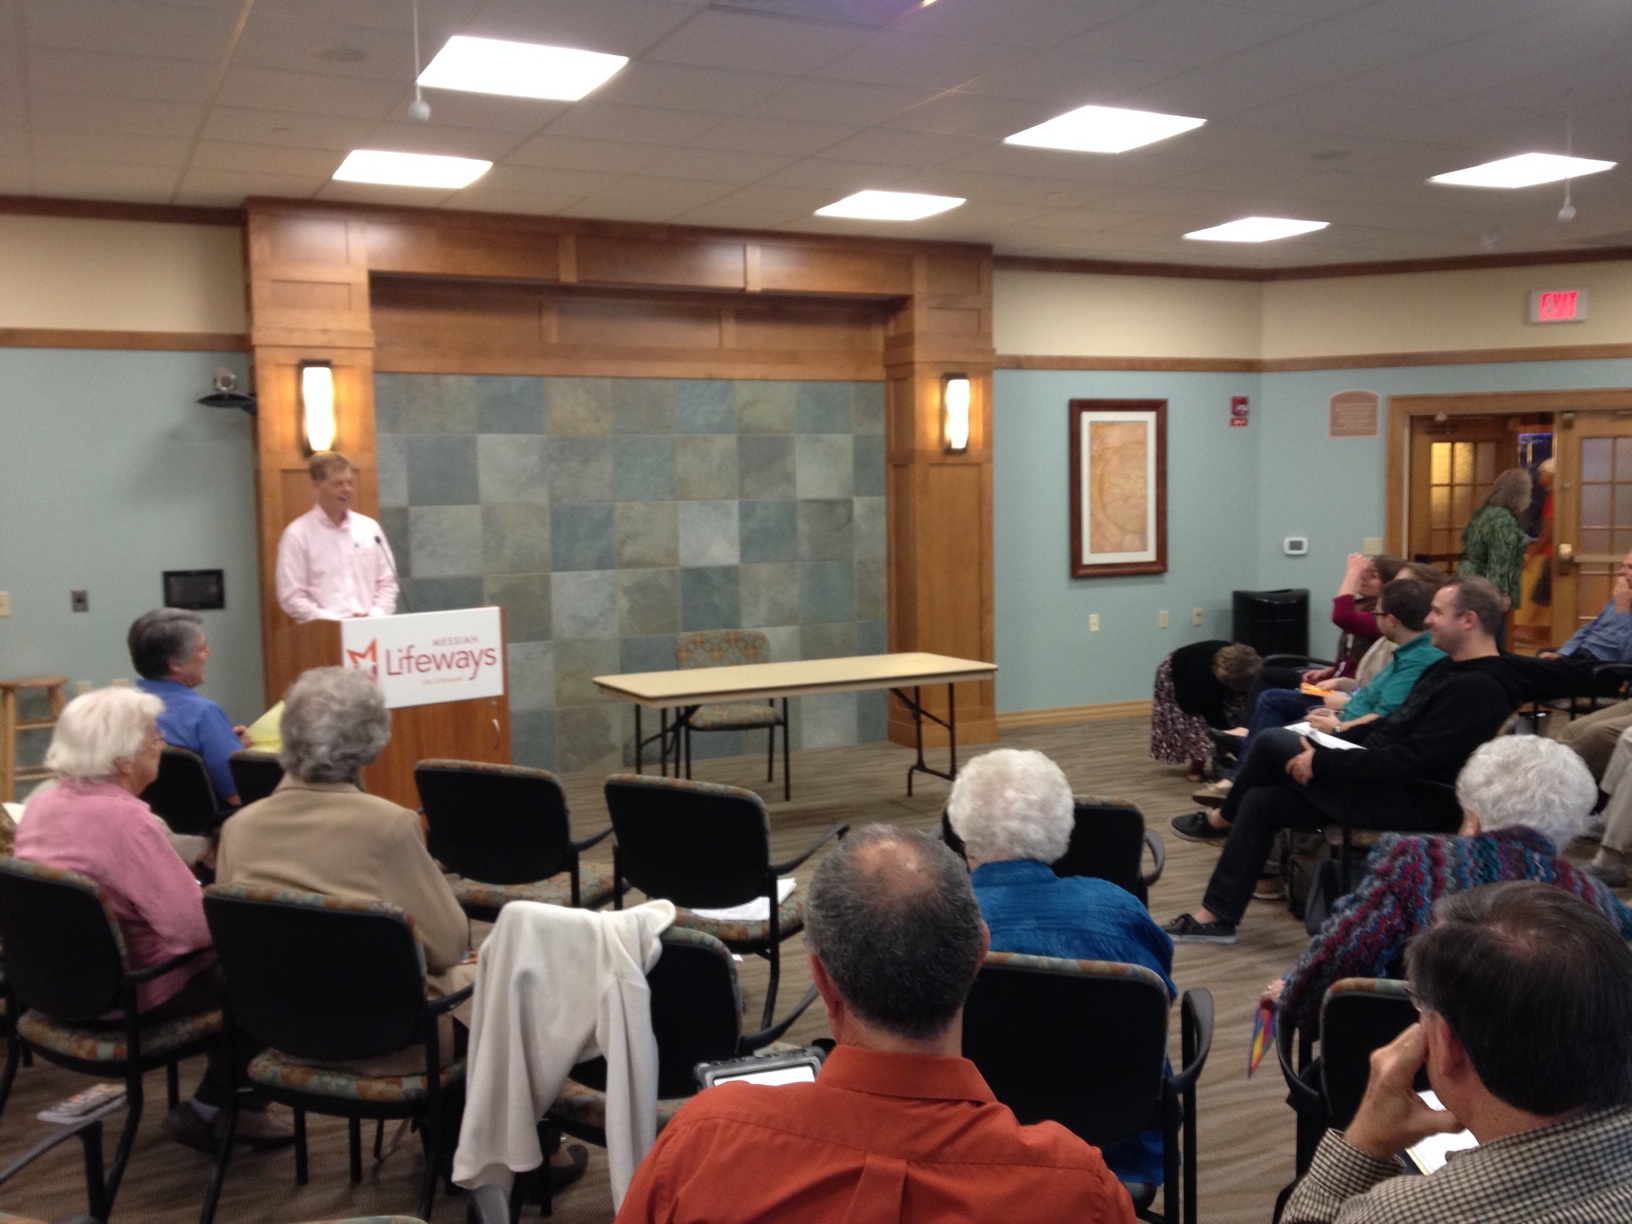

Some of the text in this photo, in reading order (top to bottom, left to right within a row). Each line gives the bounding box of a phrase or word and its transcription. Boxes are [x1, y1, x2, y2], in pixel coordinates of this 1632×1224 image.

[1539, 291, 1577, 320] EXIT
[433, 635, 478, 647] MESSIAH
[386, 645, 497, 680] Lifeways
